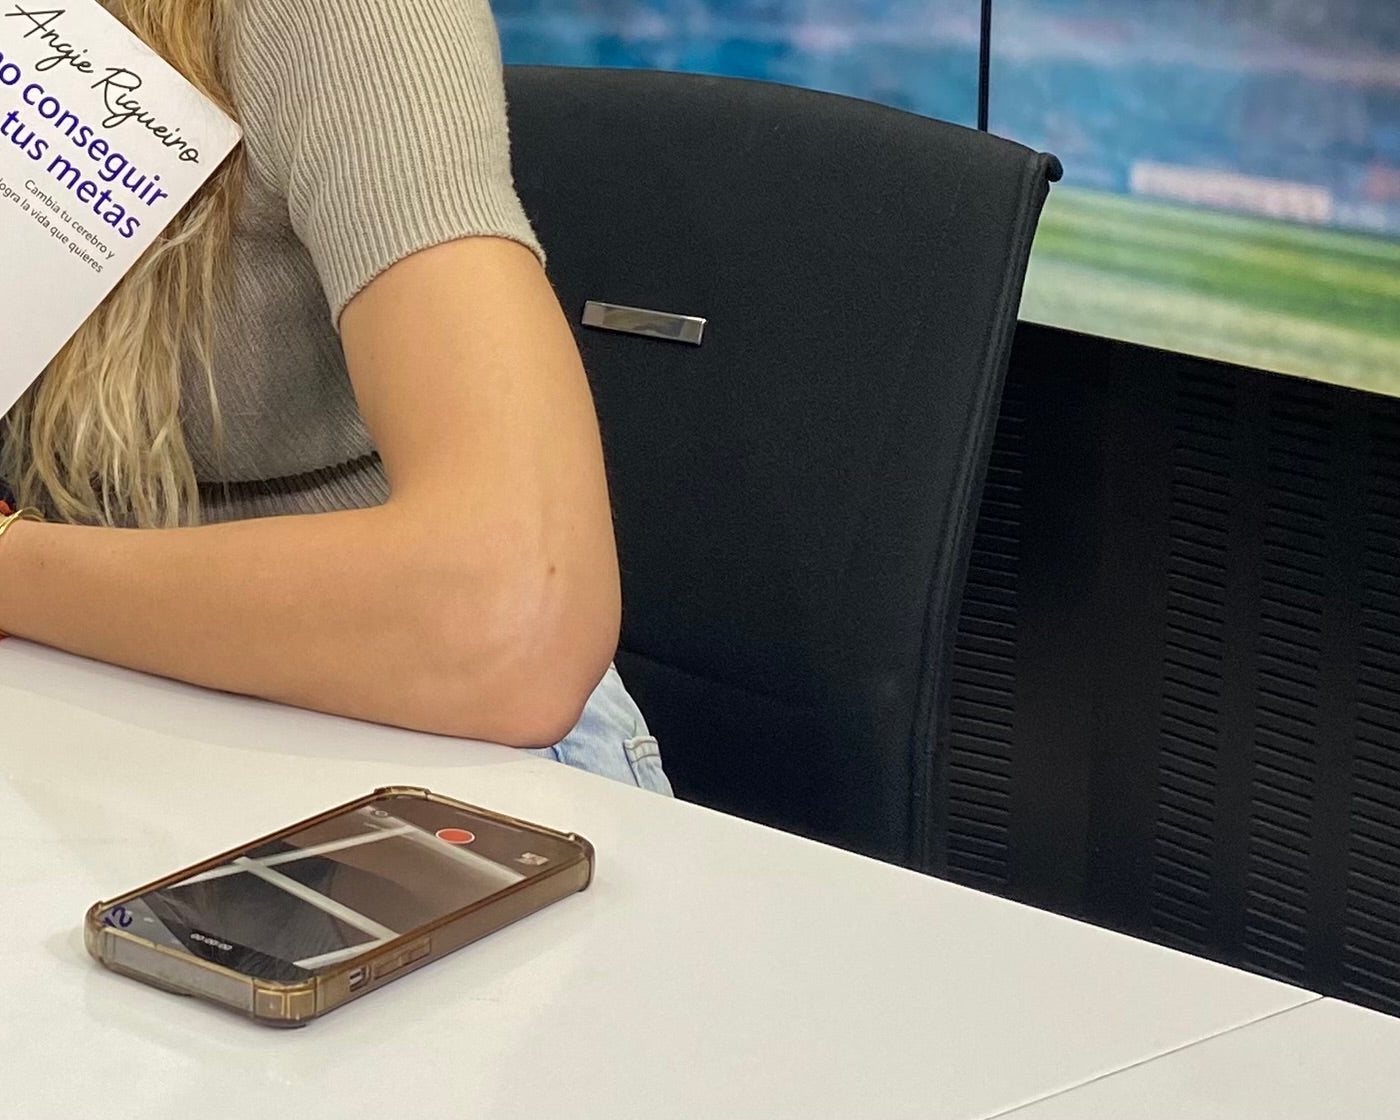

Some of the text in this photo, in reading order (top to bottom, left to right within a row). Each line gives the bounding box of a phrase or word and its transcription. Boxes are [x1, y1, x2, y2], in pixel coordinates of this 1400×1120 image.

[5, 4, 200, 164] Angie Rigueiro
[22, 83, 169, 208] conseguir
[0, 110, 142, 239] tus metas
[20, 198, 31, 211] la
[30, 209, 51, 228] vida
[50, 226, 69, 244] que
[68, 242, 104, 273] quieres
[25, 179, 61, 214] Cambia
[60, 210, 73, 223] tu
[71, 221, 108, 253] cerebro
